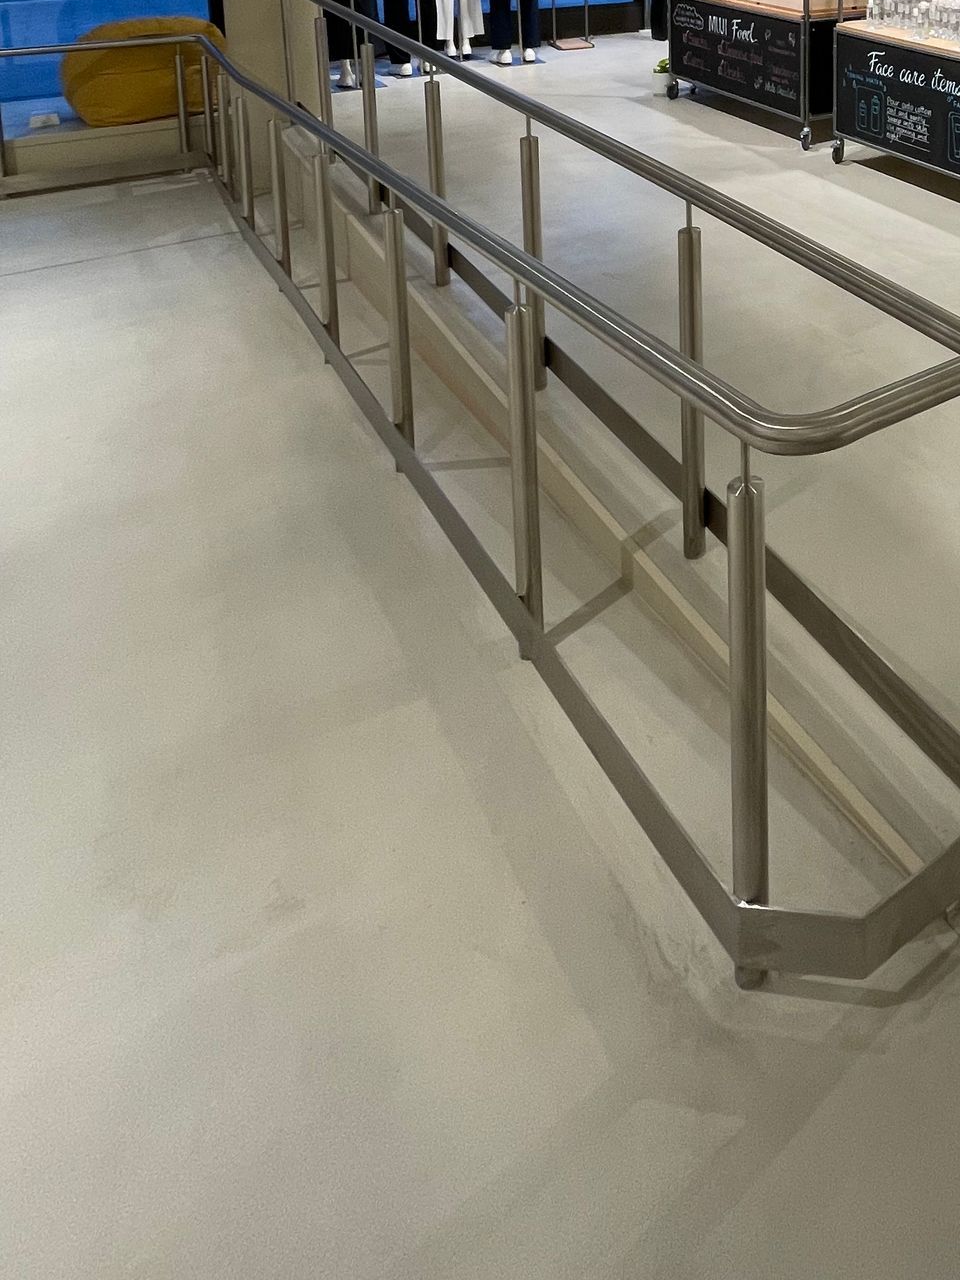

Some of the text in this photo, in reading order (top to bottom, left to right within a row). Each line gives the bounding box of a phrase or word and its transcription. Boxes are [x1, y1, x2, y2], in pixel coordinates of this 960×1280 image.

[708, 15, 728, 36] MUJI
[731, 19, 758, 43] Food
[867, 51, 894, 78] Face
[899, 68, 926, 87] care
